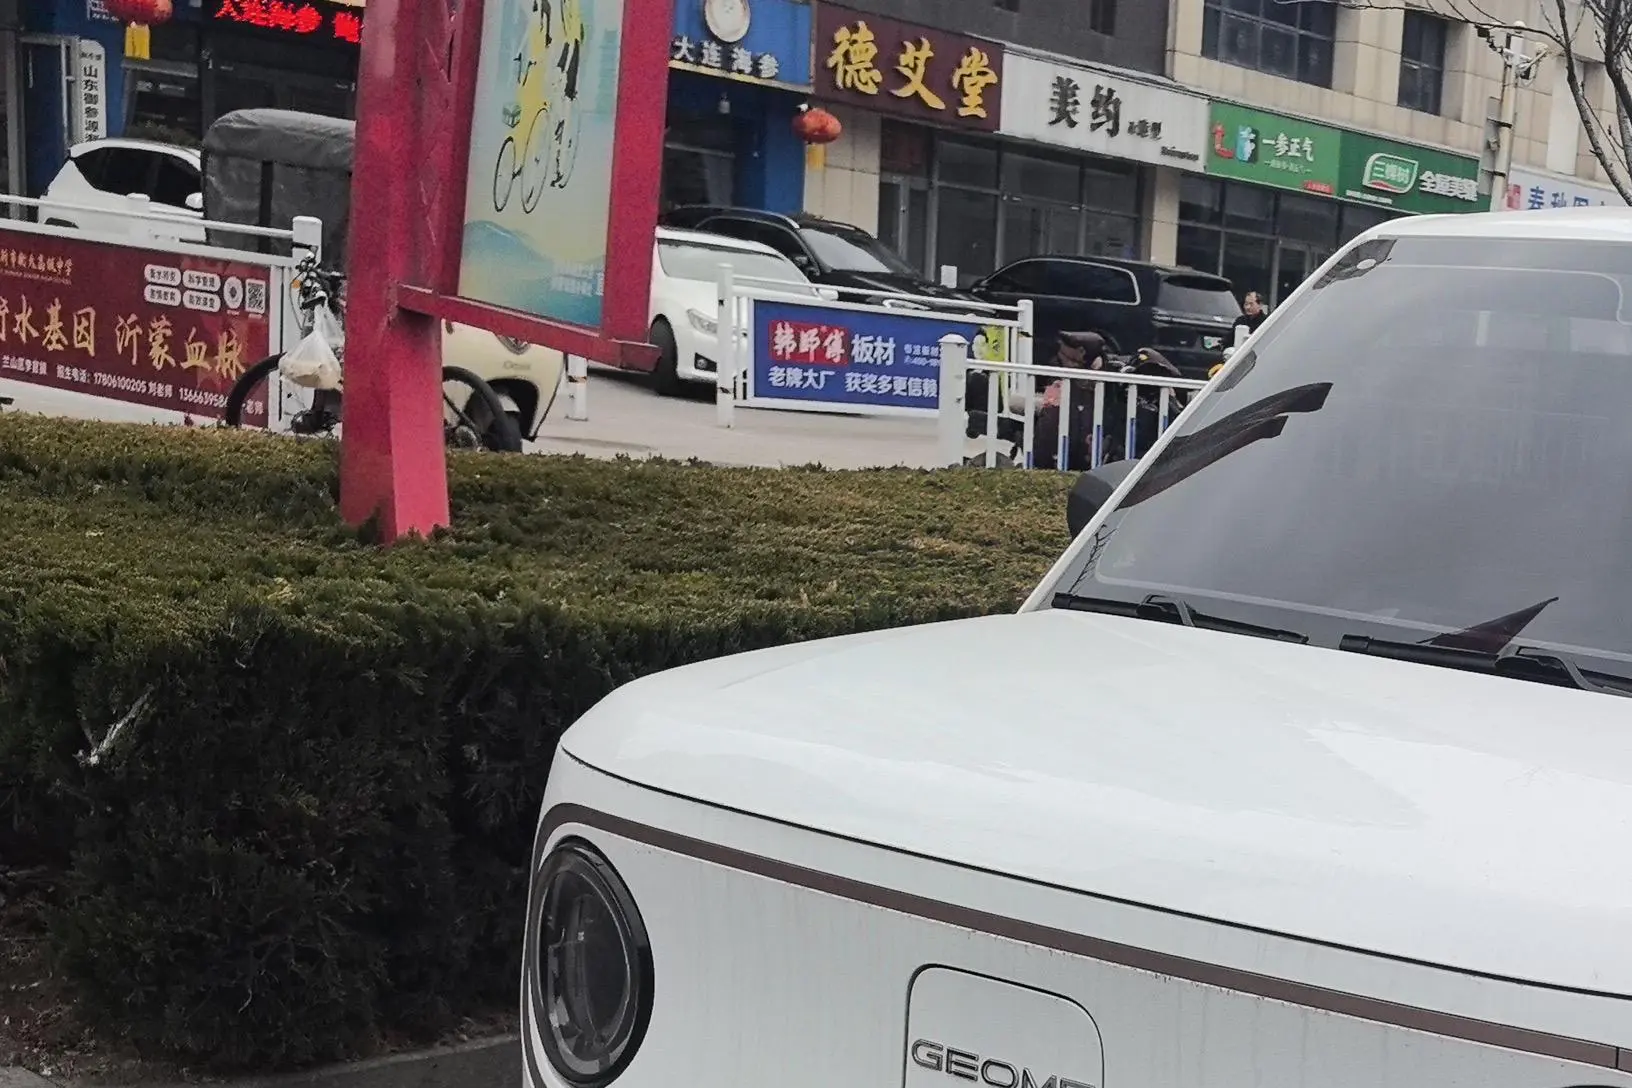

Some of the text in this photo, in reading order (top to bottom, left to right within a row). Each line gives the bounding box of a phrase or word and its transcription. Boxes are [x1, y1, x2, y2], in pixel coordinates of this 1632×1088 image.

[826, 20, 998, 118] 德艾堂
[1262, 132, 1314, 162] 一参正气
[1528, 186, 1605, 210] 春秋国
[115, 312, 247, 381] 沂蒙血脉
[851, 334, 896, 367] 板材
[768, 366, 938, 398] 老牌大厂 获奖多更信赖
